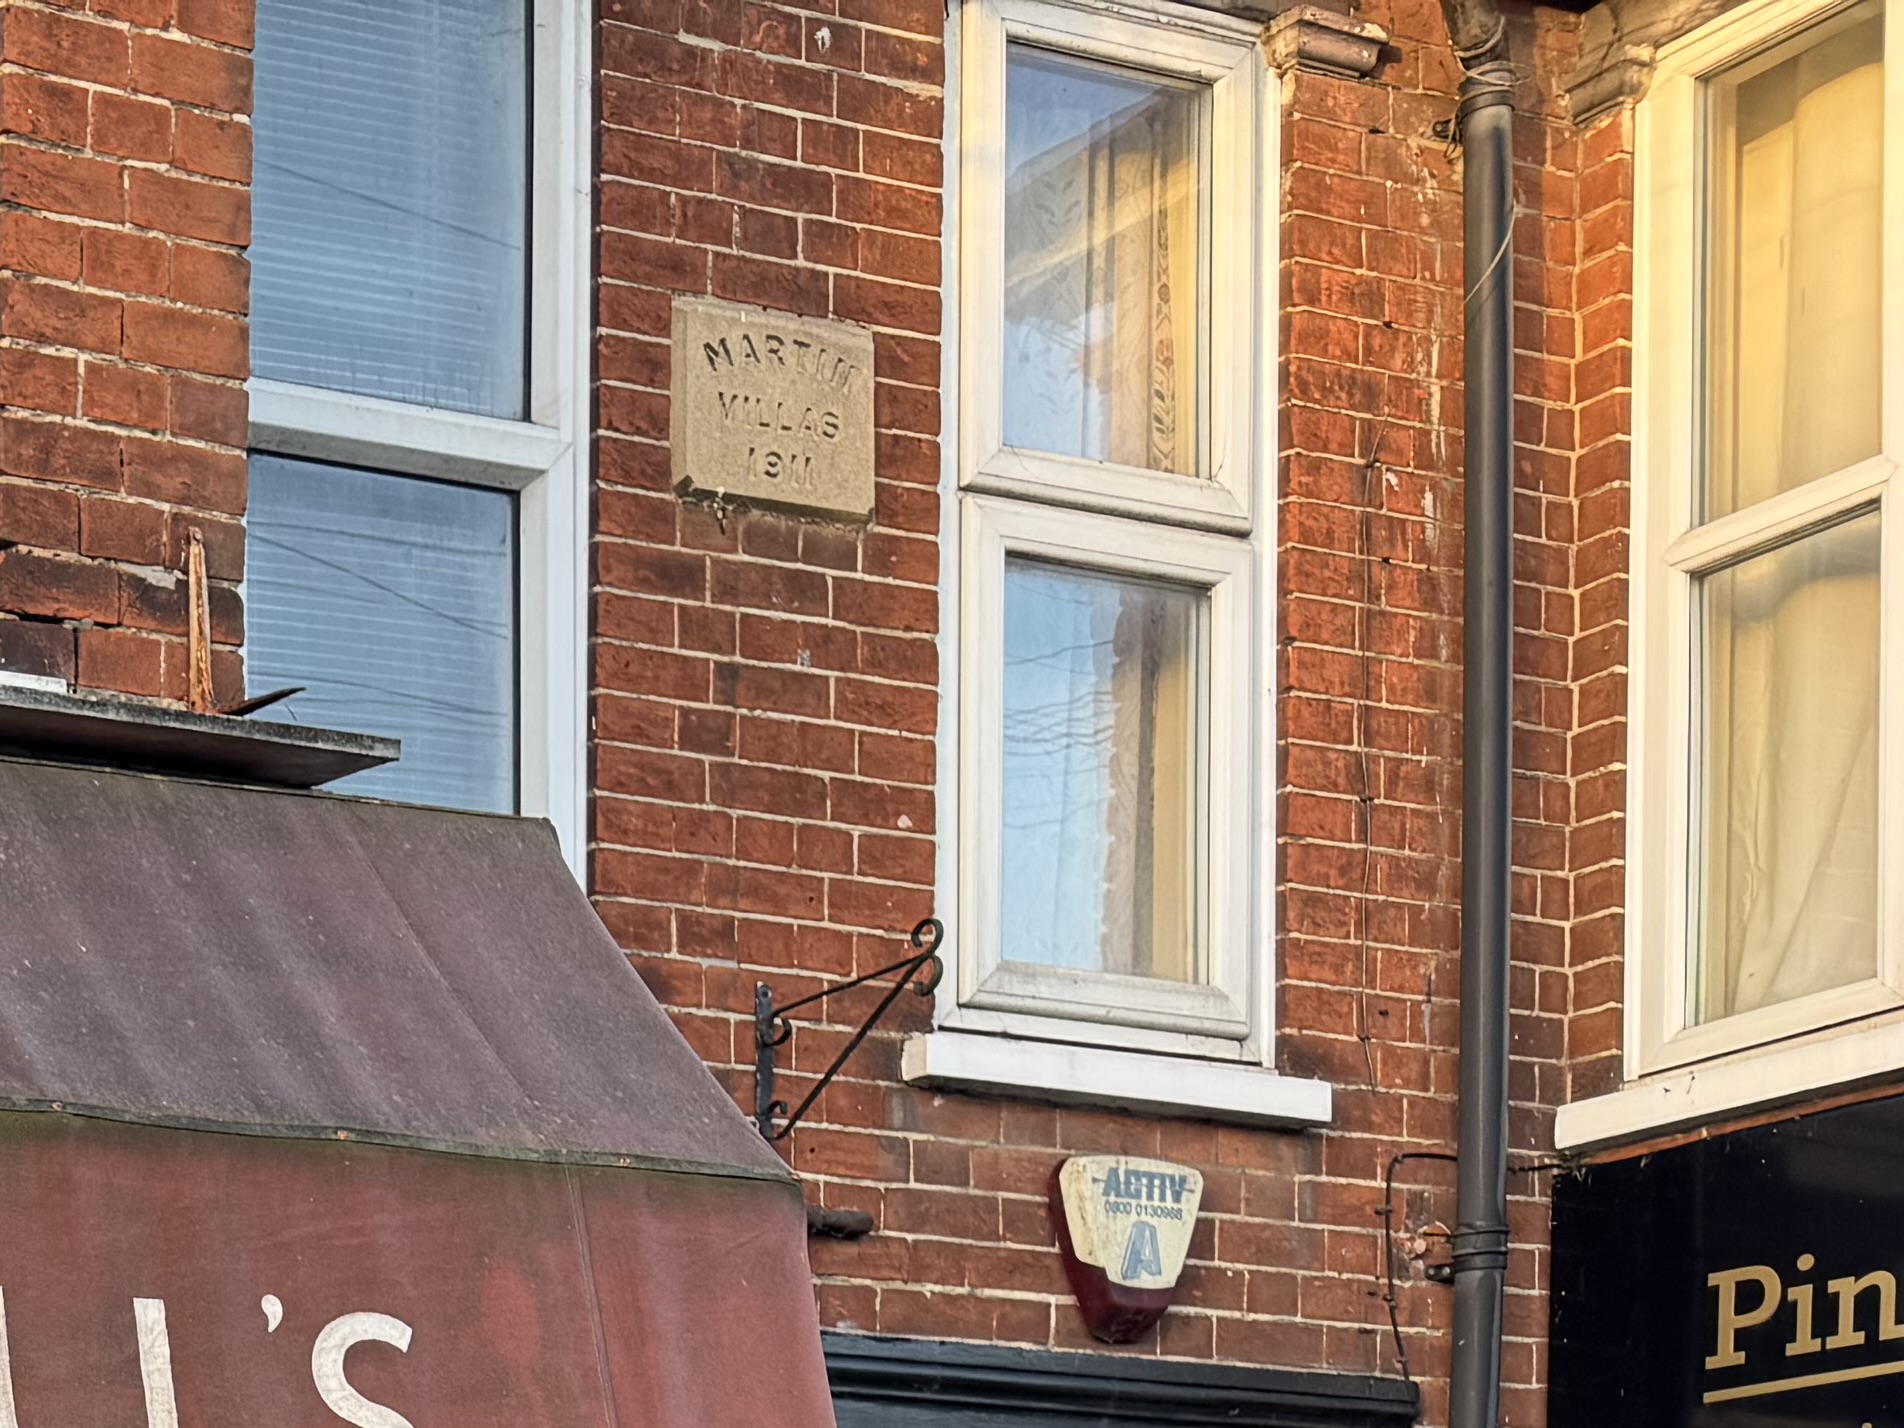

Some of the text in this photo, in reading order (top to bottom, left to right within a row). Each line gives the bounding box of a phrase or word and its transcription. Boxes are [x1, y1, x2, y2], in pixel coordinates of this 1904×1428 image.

[702, 332, 858, 396] MARTIN
[717, 391, 840, 440] VILLAS
[747, 446, 816, 488] 1911
[1101, 1166, 1188, 1204] ACTIV
